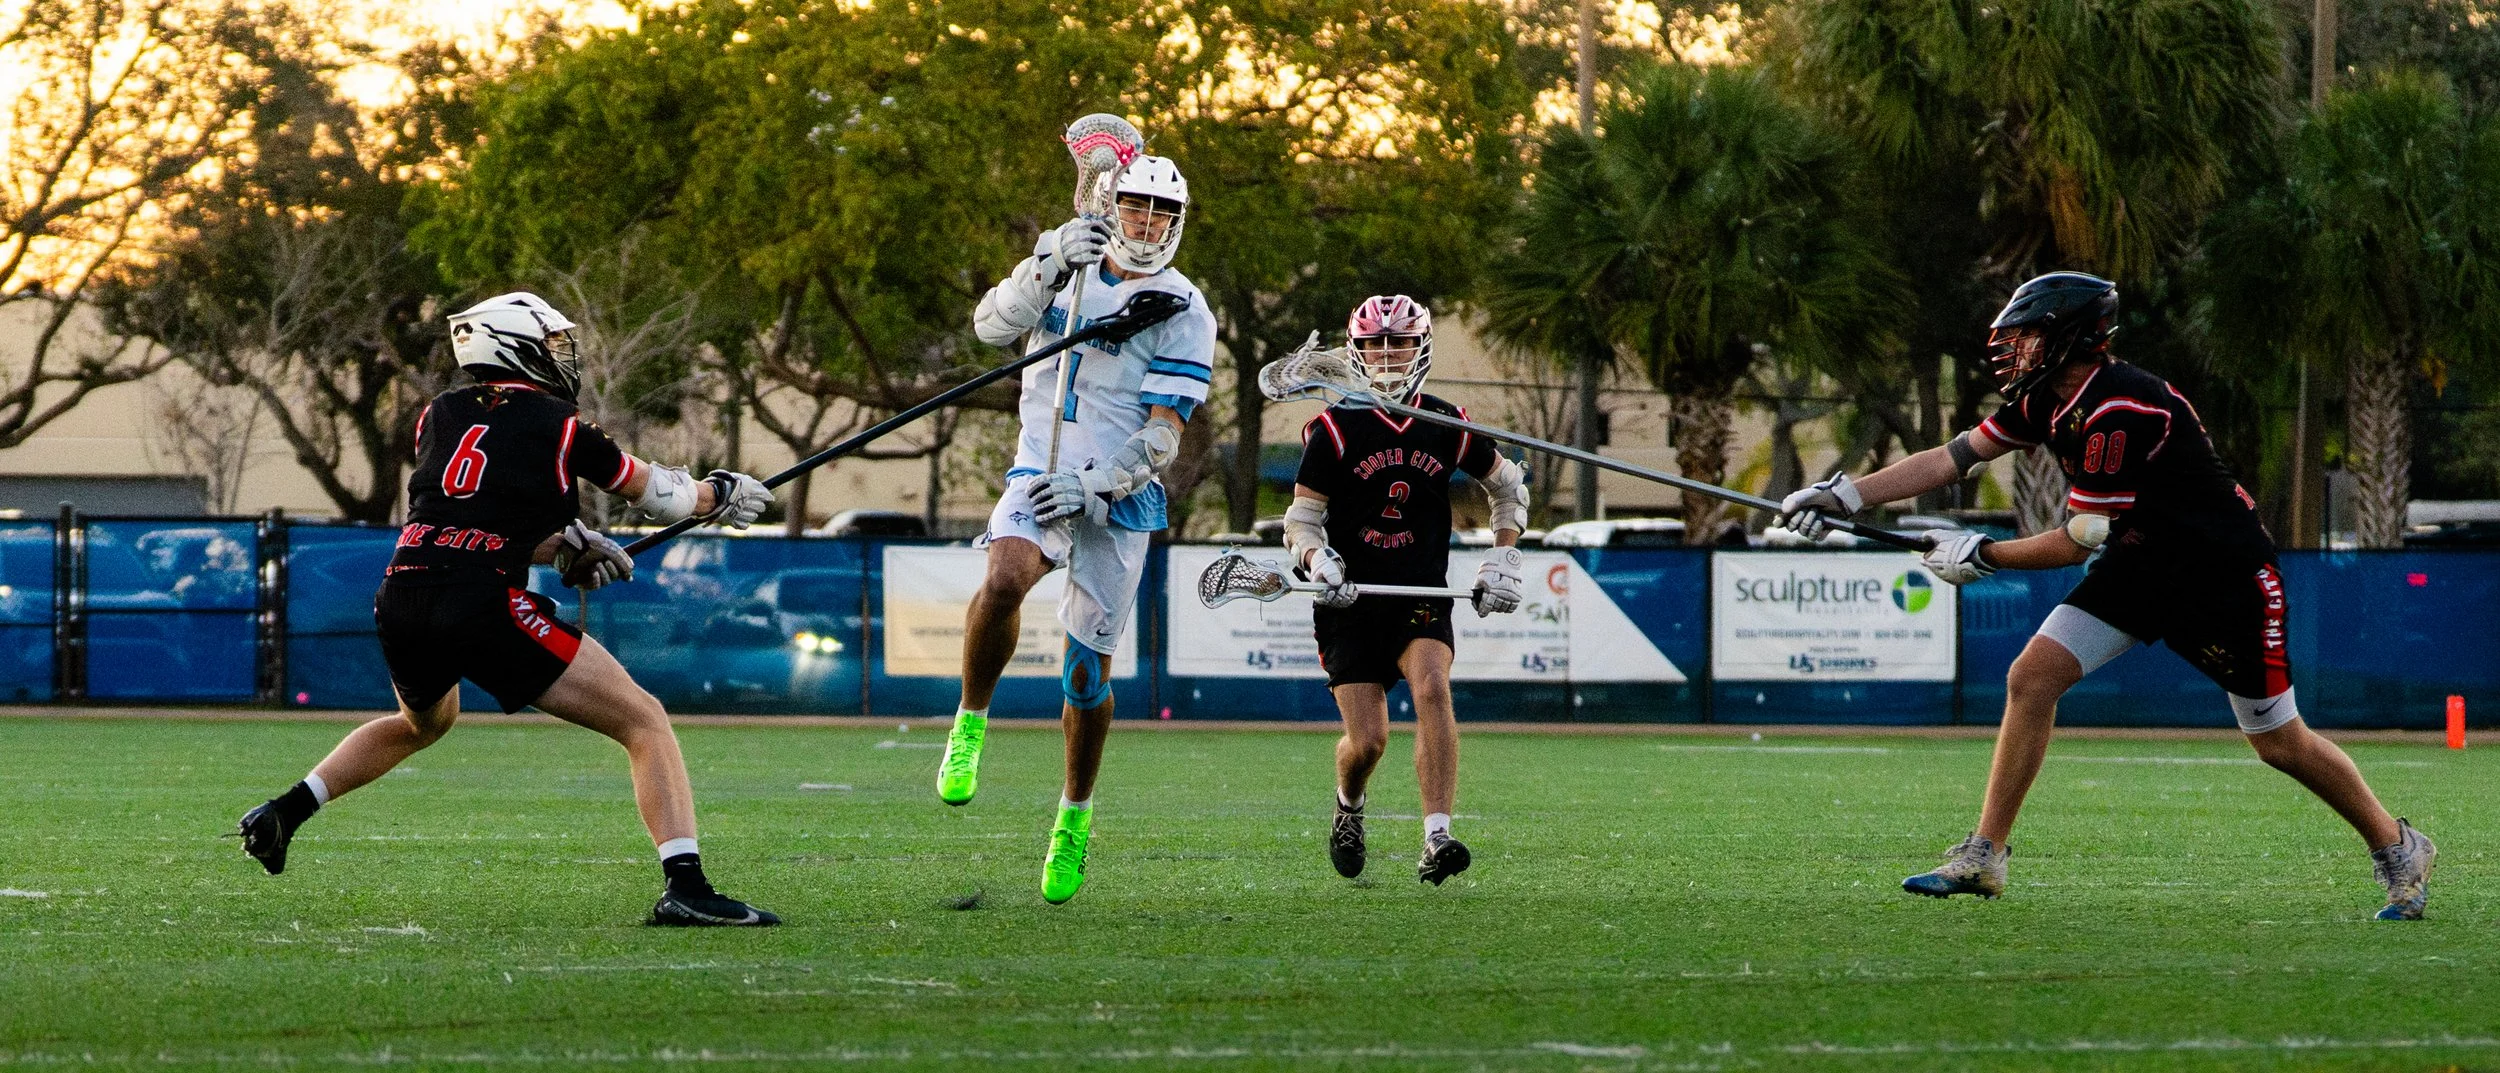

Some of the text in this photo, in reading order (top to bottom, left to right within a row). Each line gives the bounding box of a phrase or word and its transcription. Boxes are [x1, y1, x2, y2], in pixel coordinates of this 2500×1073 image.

[442, 424, 489, 498] 6
[1354, 448, 1443, 480] COOPER CITY
[2084, 430, 2126, 474] 88
[1382, 481, 1410, 519] 2
[1359, 526, 1414, 548] COWBOYS
[1736, 570, 1881, 613] sculpture
[2264, 618, 2284, 649] THE
